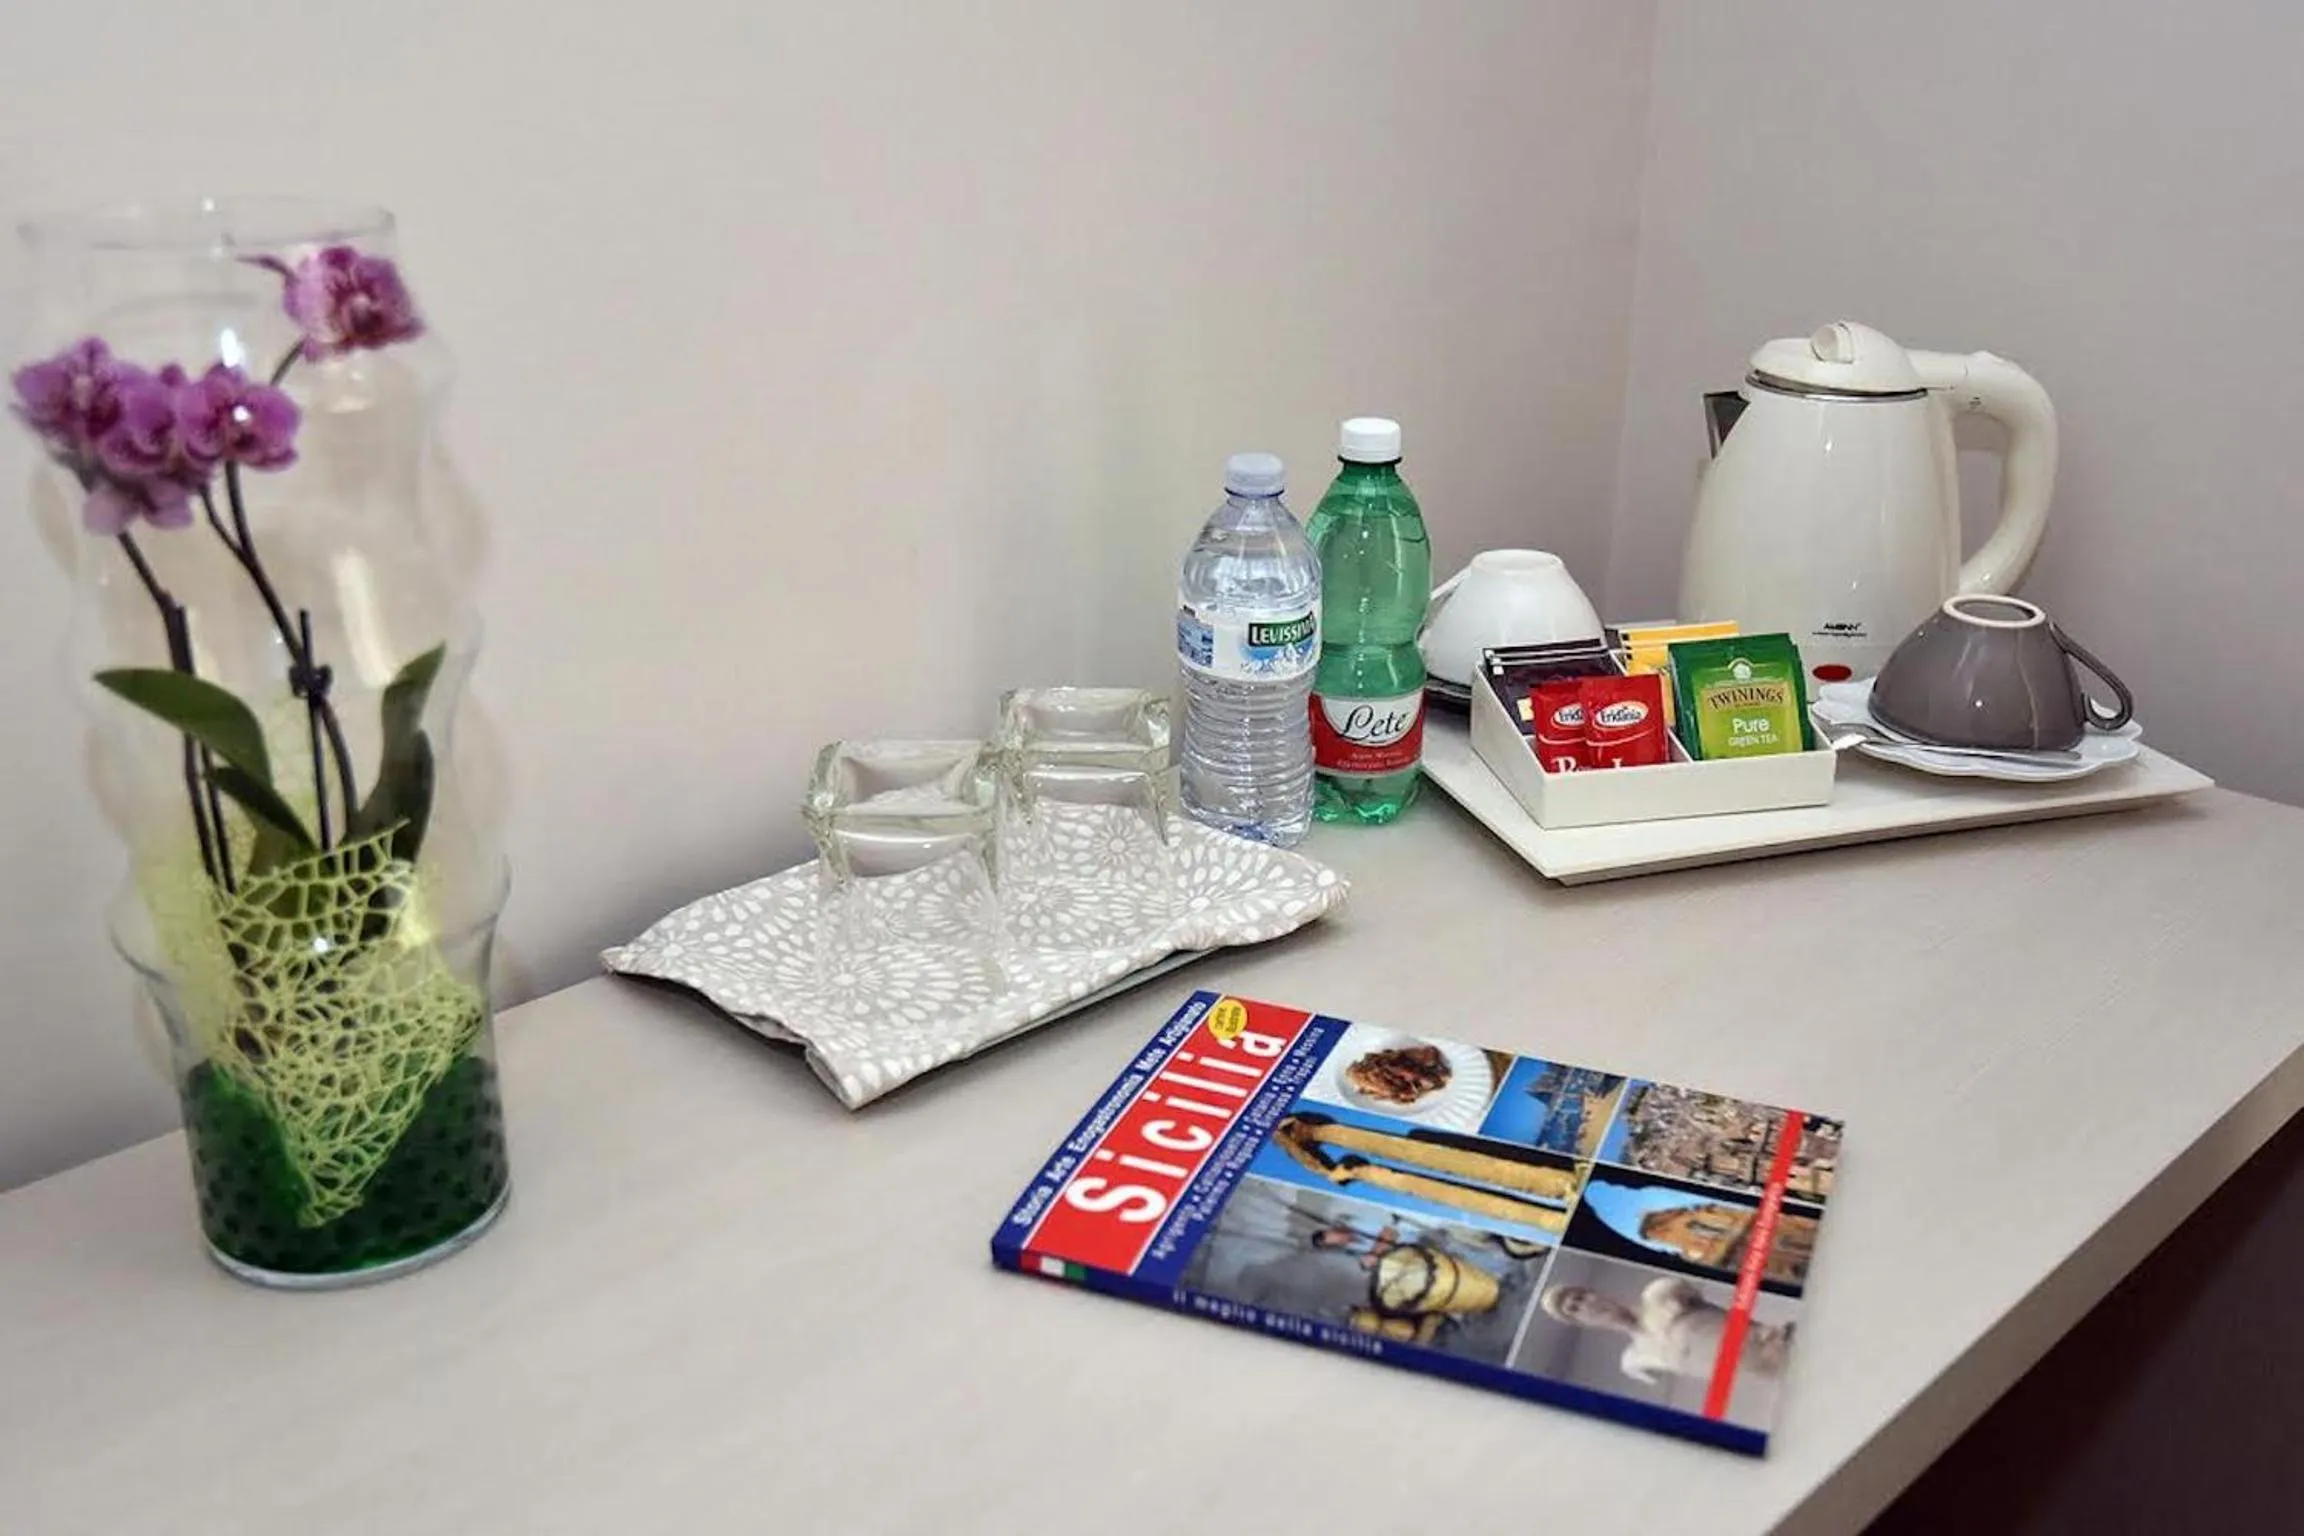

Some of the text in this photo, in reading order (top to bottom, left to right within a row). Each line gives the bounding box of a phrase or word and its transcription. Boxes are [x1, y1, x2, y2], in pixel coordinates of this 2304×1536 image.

[1708, 687, 1784, 709] TWININGS
[1732, 717, 1769, 734] Pure
[1728, 733, 1779, 747] GREEN TEA
[1064, 1030, 1287, 1223] Sicilia
[1040, 1153, 1079, 1183] Arte
